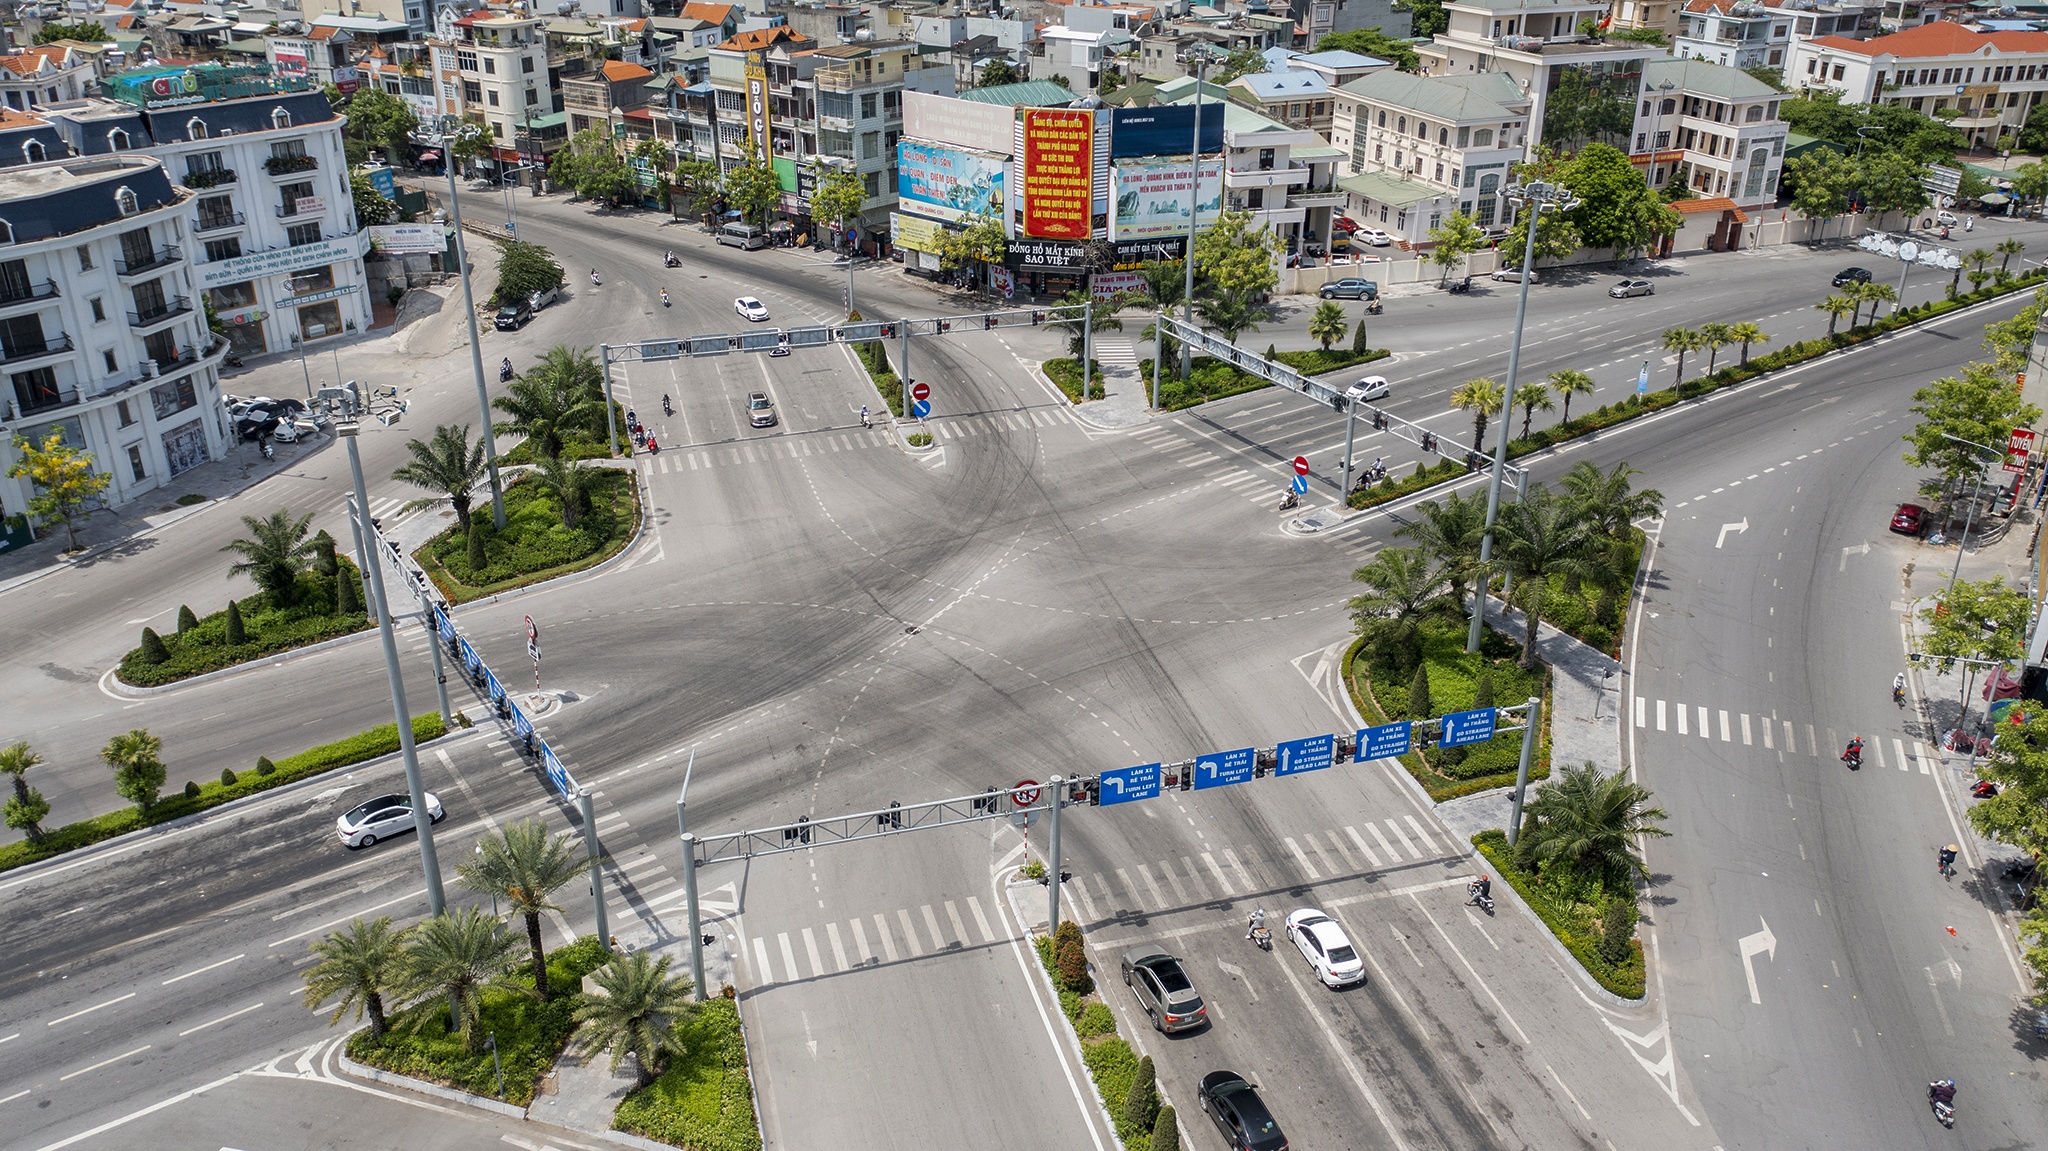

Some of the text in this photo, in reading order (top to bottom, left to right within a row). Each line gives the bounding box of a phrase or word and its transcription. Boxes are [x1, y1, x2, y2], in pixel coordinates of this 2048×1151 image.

[912, 151, 927, 163] LONG
[1064, 247, 1084, 256] KÍNH
[1025, 254, 1070, 266] SAO VIỆT
[1465, 727, 1491, 735] STRAIGHT
[1380, 741, 1407, 749] STRAIGHT
[1304, 754, 1330, 762] STRAIGHT
